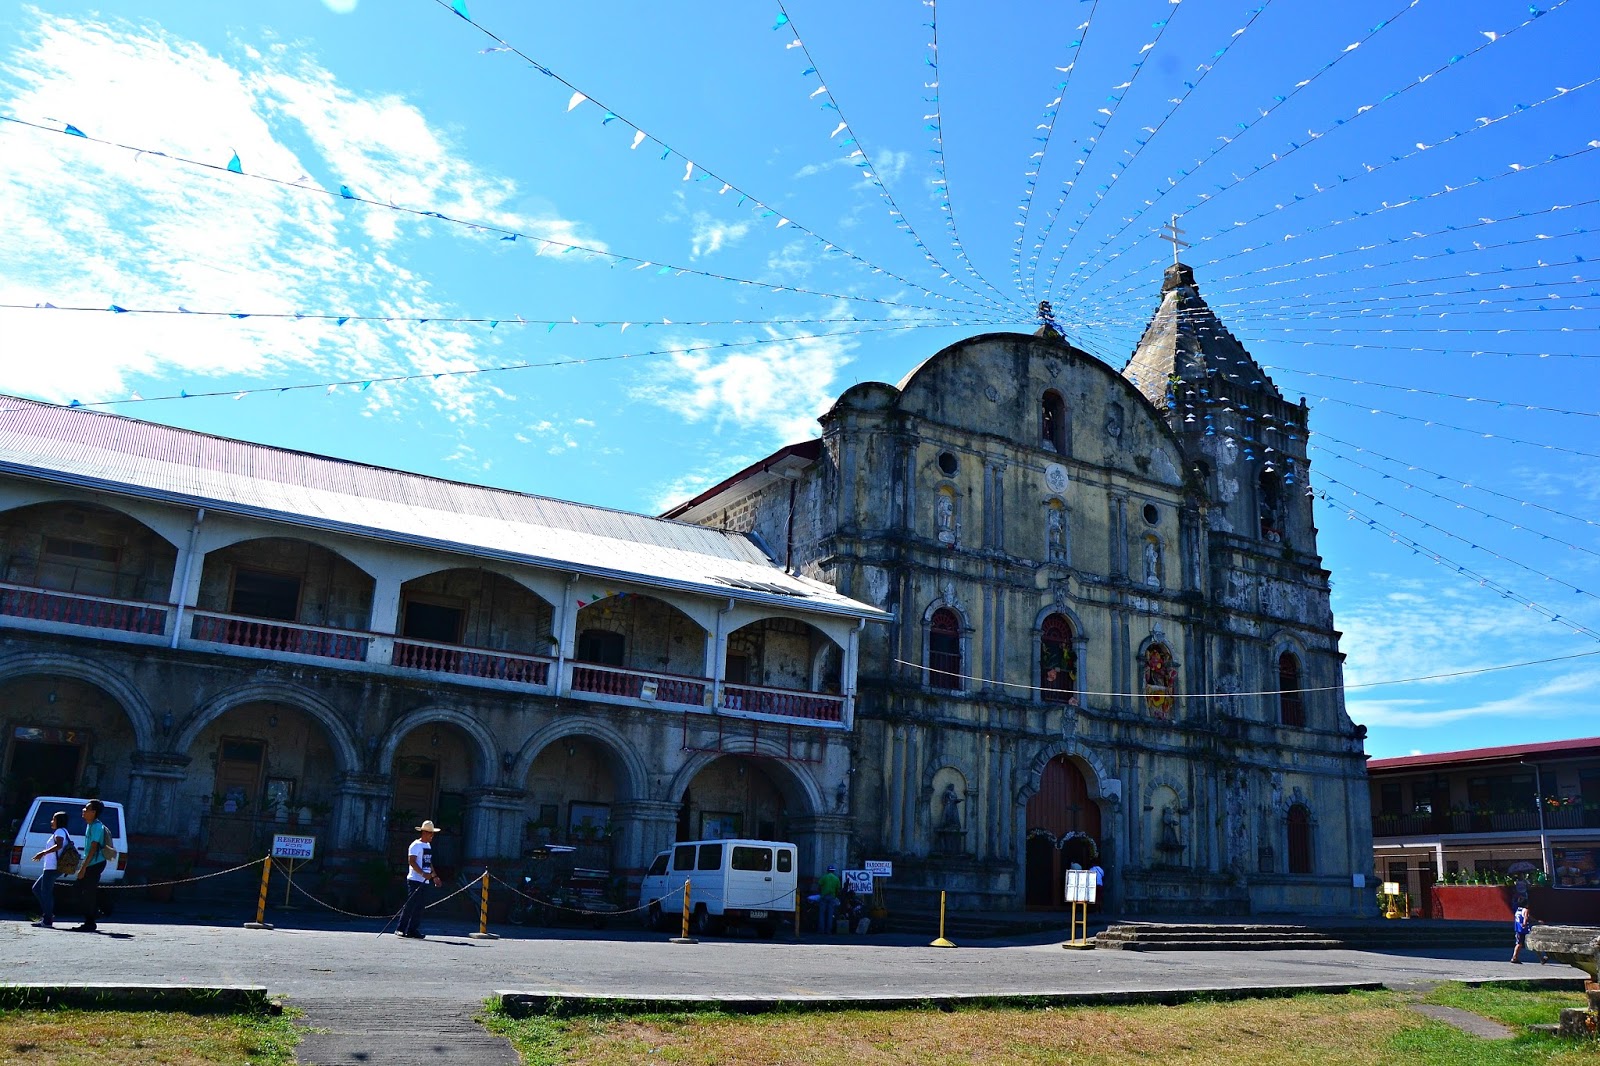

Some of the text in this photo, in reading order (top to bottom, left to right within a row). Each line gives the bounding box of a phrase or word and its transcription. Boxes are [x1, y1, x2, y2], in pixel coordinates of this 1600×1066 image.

[277, 836, 312, 844] RESERVED
[275, 847, 311, 856] PRIESTS
[845, 871, 870, 881] NO
